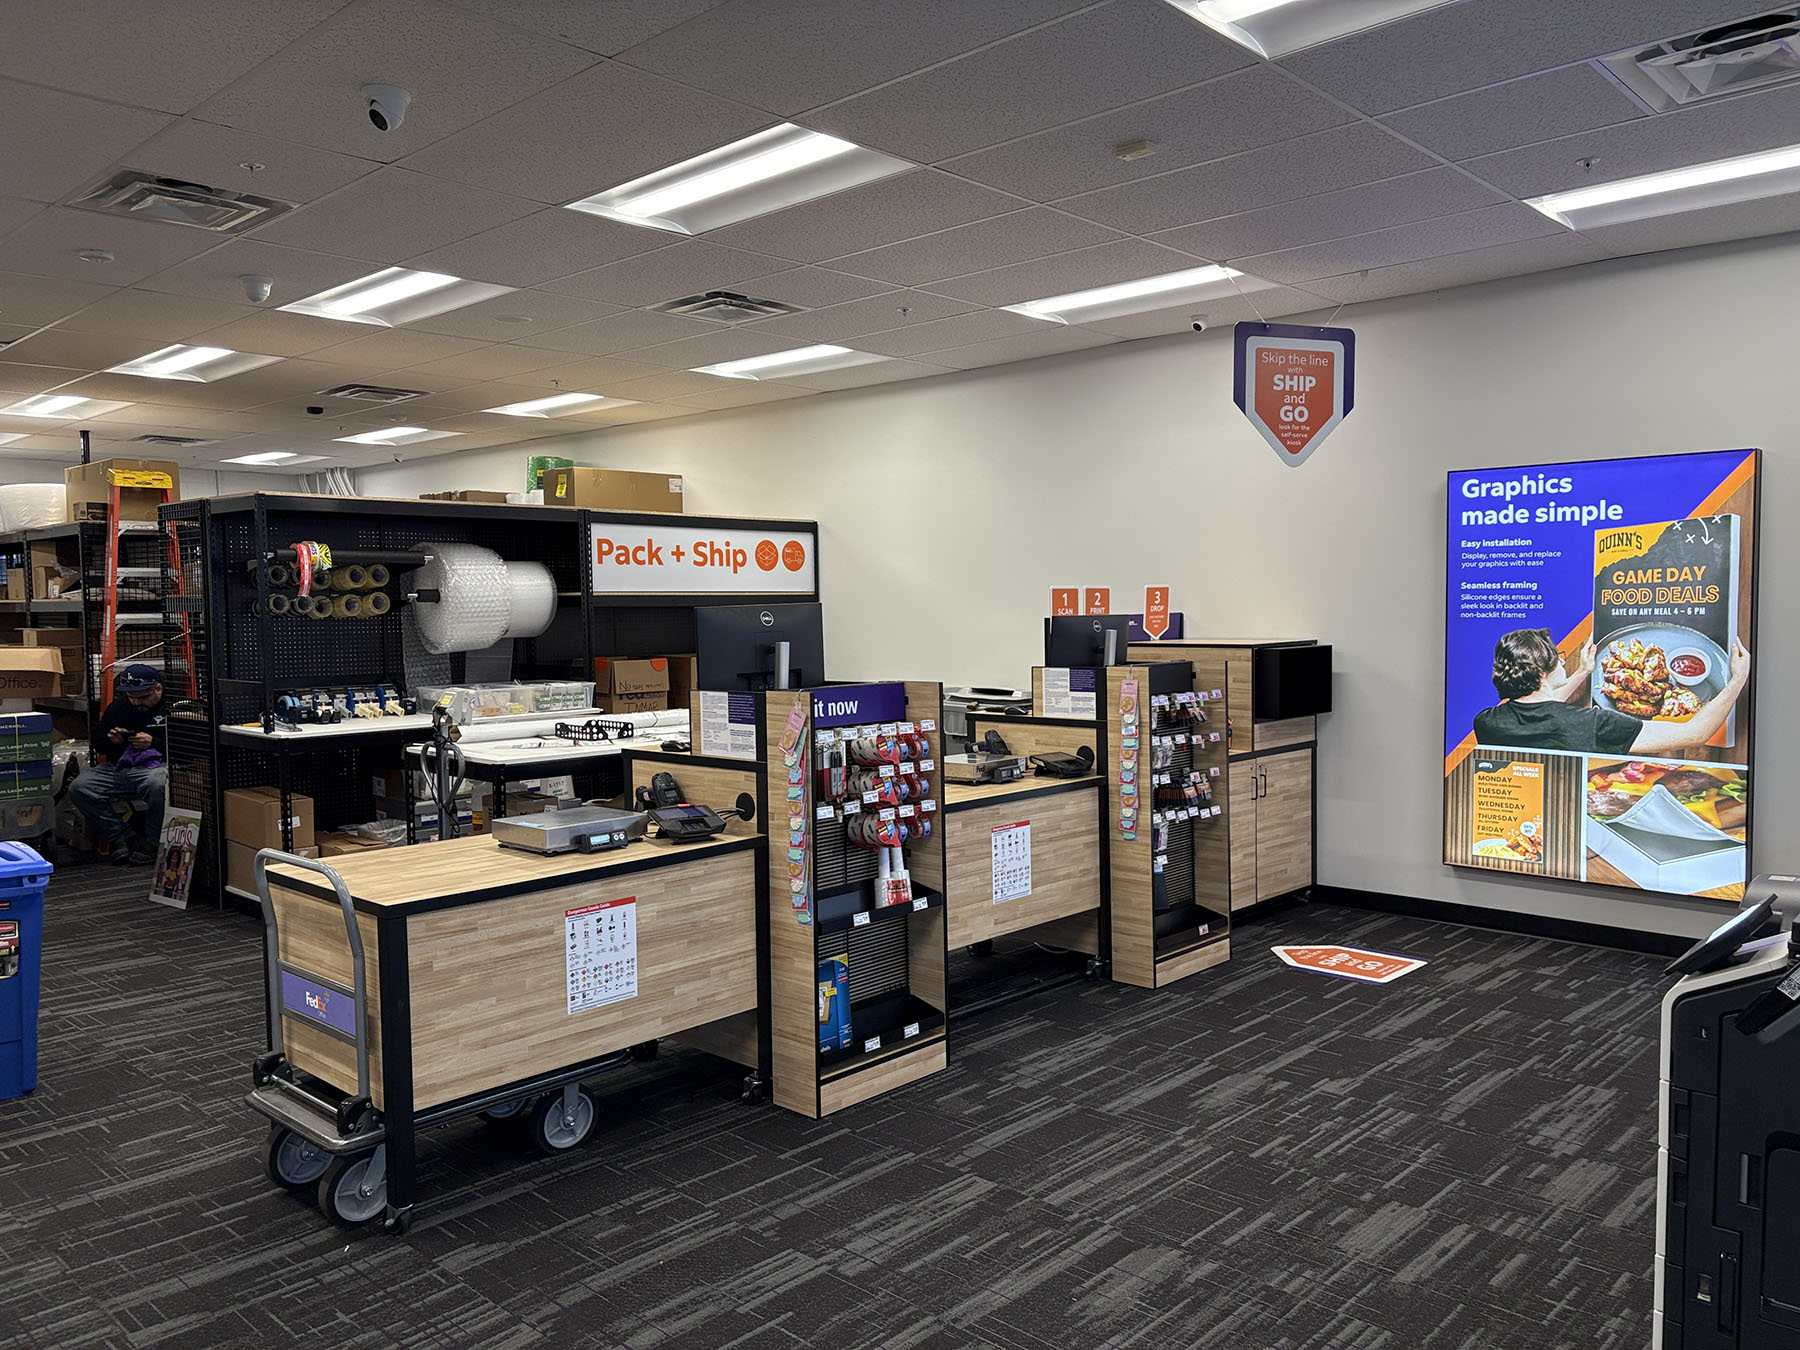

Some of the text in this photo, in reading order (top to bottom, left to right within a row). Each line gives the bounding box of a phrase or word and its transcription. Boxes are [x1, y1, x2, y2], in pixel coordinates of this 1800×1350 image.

[1261, 352, 1329, 367] Skip the line
[1272, 374, 1316, 392] SHIP
[1283, 393, 1306, 404] and
[1279, 405, 1309, 423] GO
[1461, 473, 1573, 501] Graphics
[1461, 499, 1624, 527] made simple
[1461, 538, 1533, 549] Easy installation
[1599, 531, 1643, 554] QUINN'S
[596, 538, 664, 567] Pack
[692, 541, 748, 574] Ship
[1461, 552, 1489, 560] Display,
[1534, 550, 1562, 559] replace
[1461, 561, 1477, 569] your
[1478, 560, 1509, 569] graphics
[1612, 565, 1707, 585] GAME DAY
[1460, 581, 1538, 591] Seamless framing
[1062, 592, 1068, 606] 1
[1094, 592, 1101, 606] 2
[1154, 591, 1161, 604] 3
[1460, 593, 1487, 601] Silicone
[1488, 593, 1510, 602] edges
[1601, 584, 1721, 606] FOOD DEALS
[1057, 608, 1073, 616] SCAN
[1501, 611, 1527, 619] frames
[1611, 607, 1627, 616] SAVE
[1628, 607, 1638, 616] ON
[1639, 607, 1652, 616] ANY
[1653, 606, 1672, 615] MEAL
[1673, 606, 1679, 615] 4
[1687, 606, 1692, 615] 6
[1694, 606, 1706, 615] PM
[814, 698, 858, 718] it now
[1477, 775, 1512, 784] MONDAY
[1477, 787, 1512, 796] TUESDAY
[1477, 800, 1526, 811] WEDNESDAY
[1477, 813, 1518, 823] THURSDAY
[1477, 825, 1505, 834] FRIDAY
[1317, 952, 1351, 967] SHIP
[1356, 960, 1384, 971] GO
[305, 991, 328, 1013] FedEx
